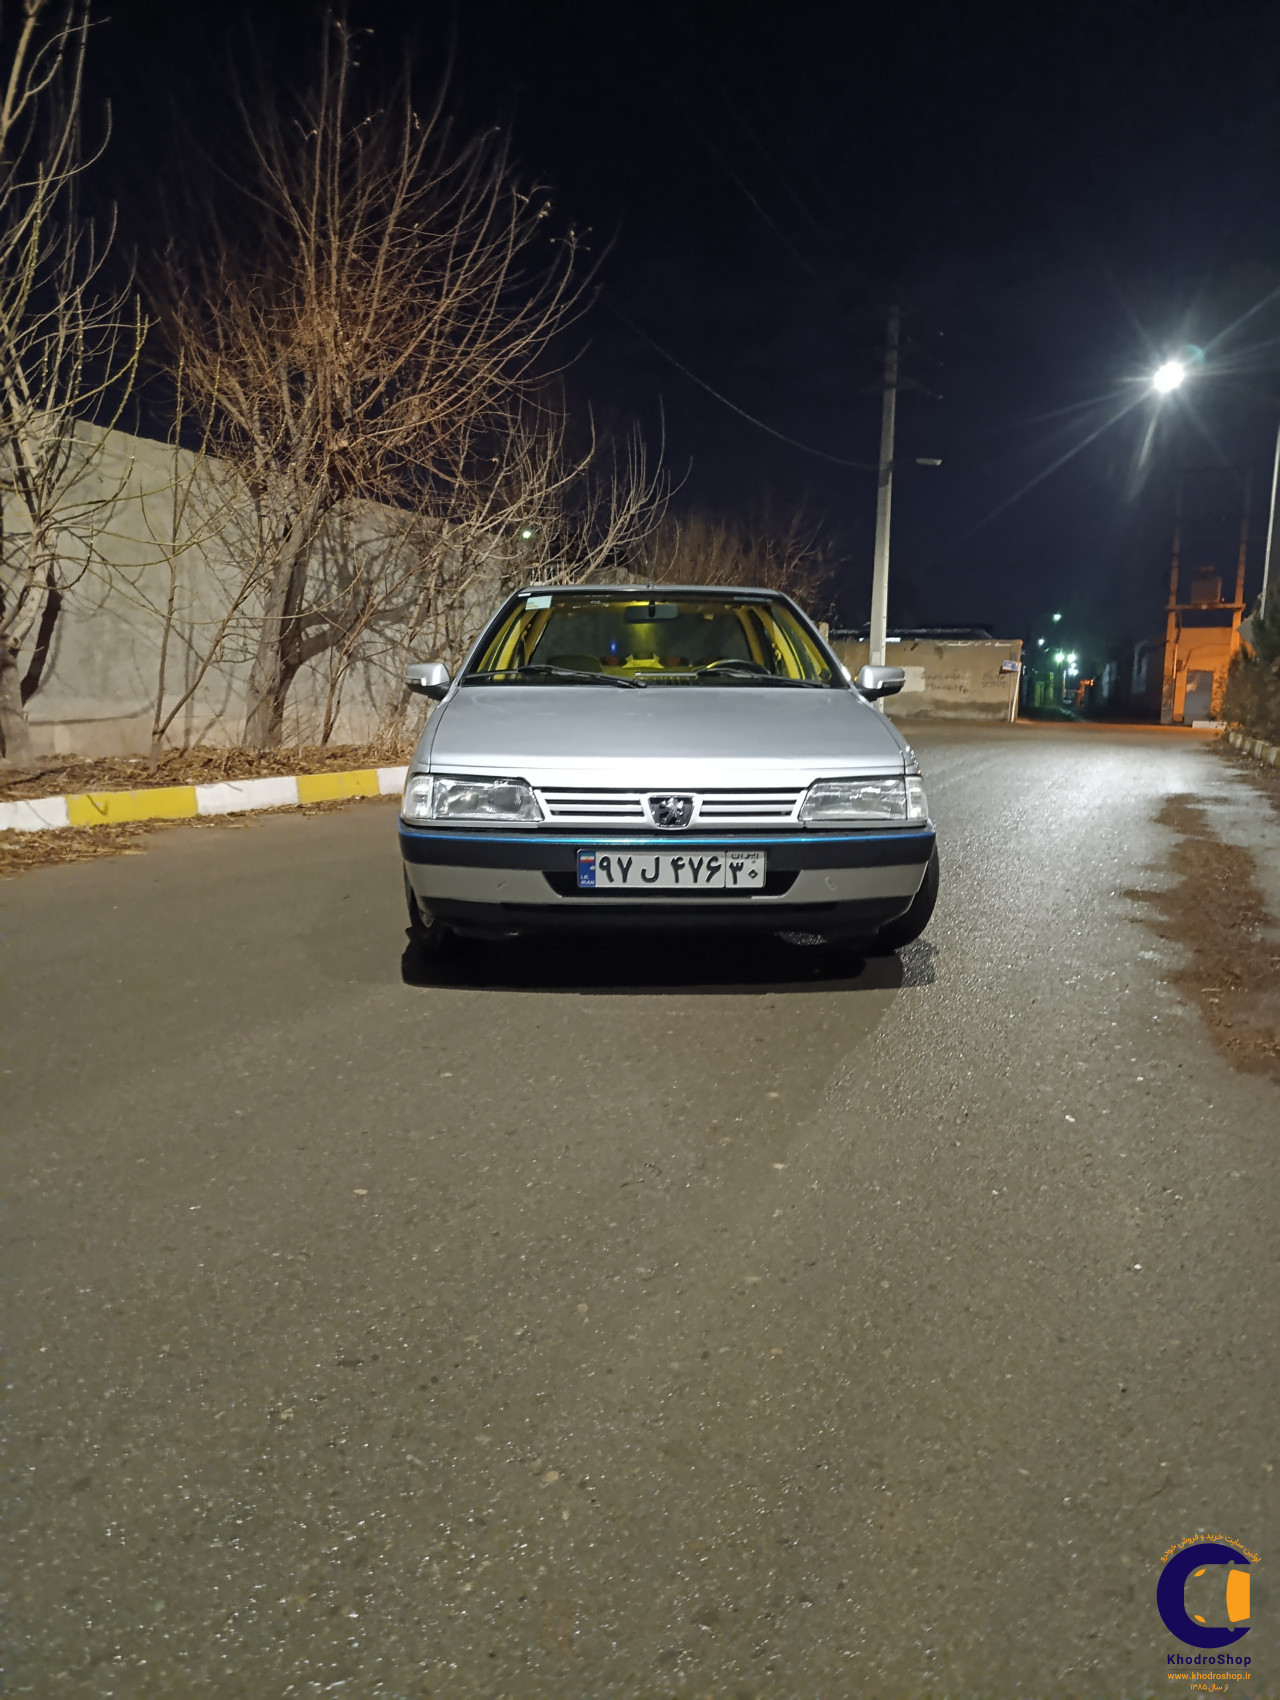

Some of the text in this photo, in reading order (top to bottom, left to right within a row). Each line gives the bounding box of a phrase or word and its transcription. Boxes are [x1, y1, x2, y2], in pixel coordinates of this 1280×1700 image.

[598, 855, 759, 885] ۹۷ ل ۴۷۶ ۳۰
